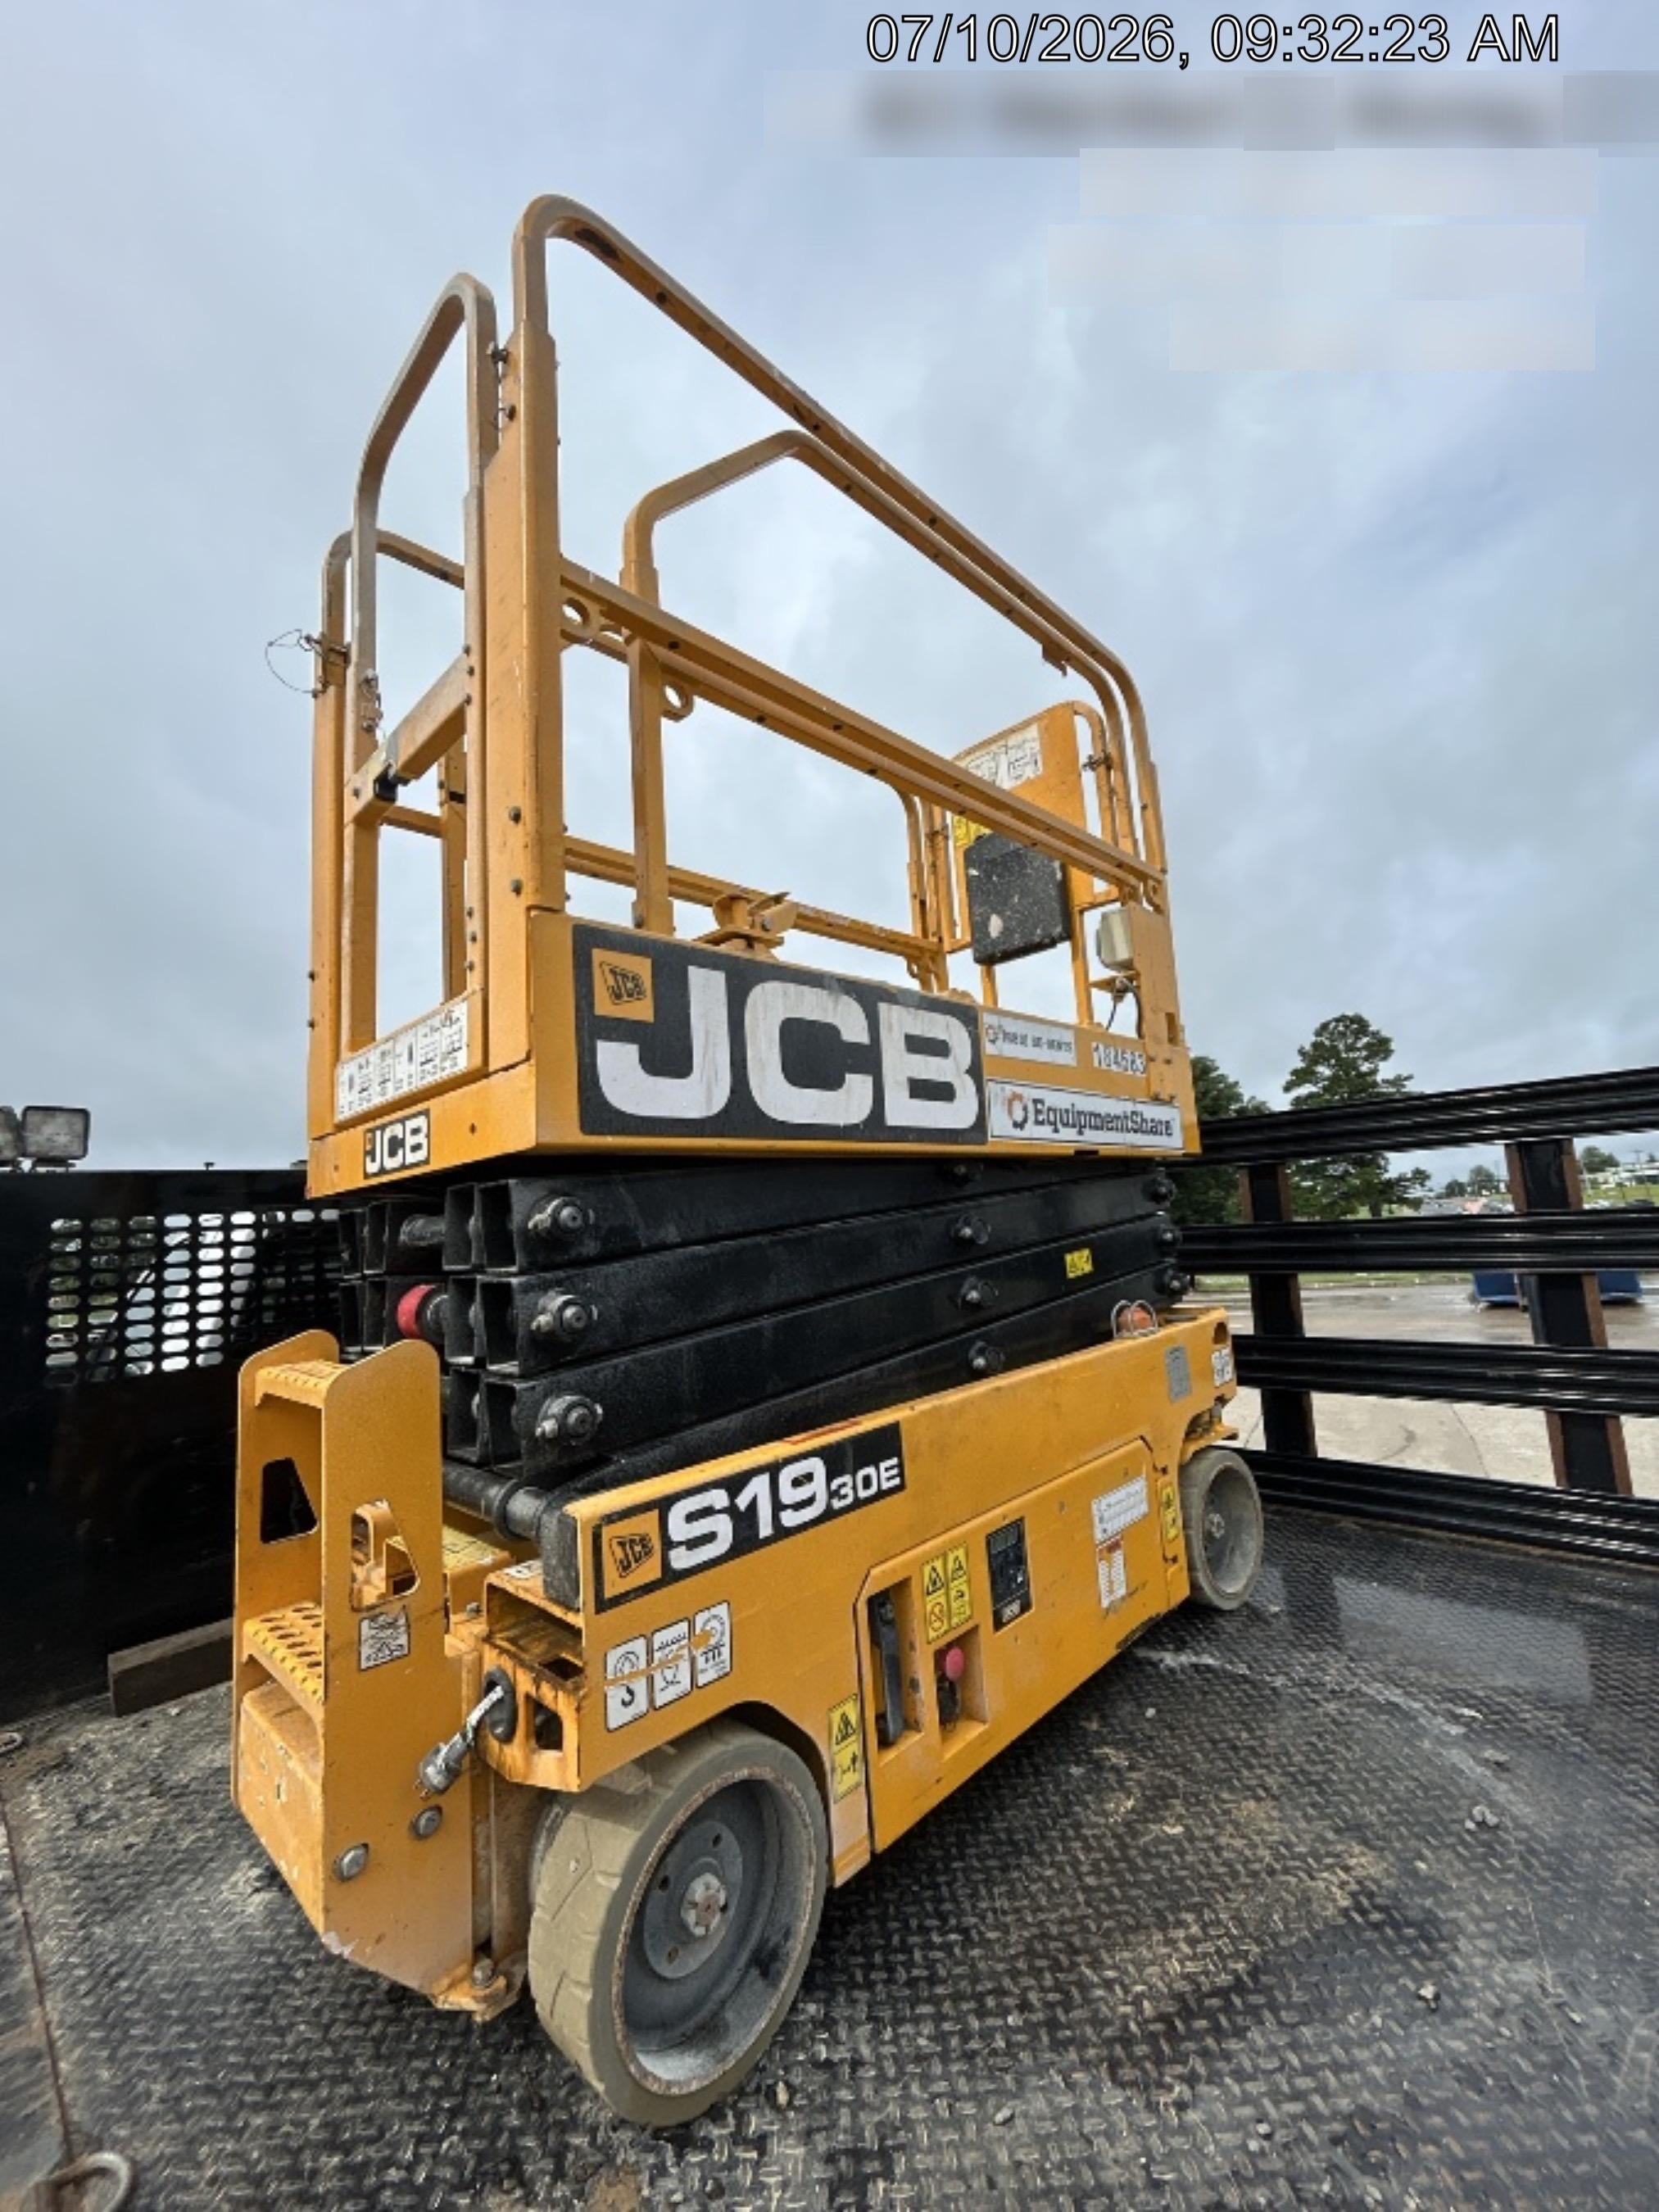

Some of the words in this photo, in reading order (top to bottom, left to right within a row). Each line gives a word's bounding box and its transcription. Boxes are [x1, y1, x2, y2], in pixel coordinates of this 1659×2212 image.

[609, 968, 644, 999] JCB
[596, 965, 979, 1129] JCB
[1031, 1098, 1173, 1136] EquipmentShare
[365, 1115, 428, 1174] JCB
[616, 1537, 653, 1572] JCB
